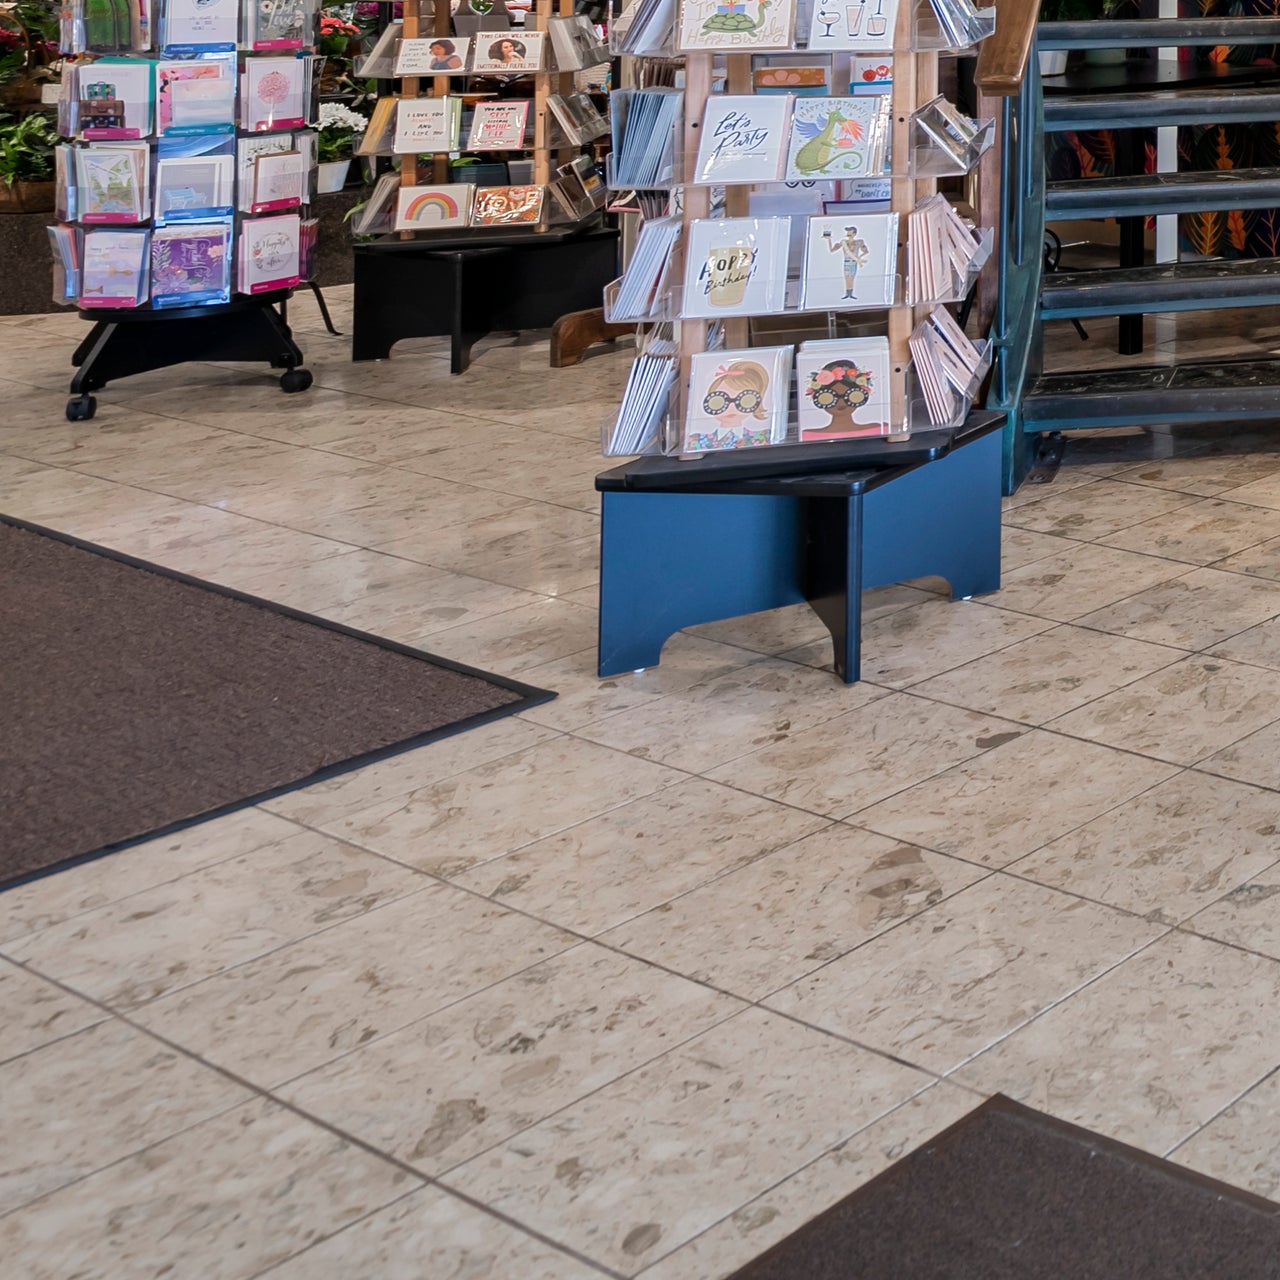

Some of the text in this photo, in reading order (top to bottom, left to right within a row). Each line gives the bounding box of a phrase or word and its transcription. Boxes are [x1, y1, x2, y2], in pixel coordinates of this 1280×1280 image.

[800, 99, 868, 118] HAPPY BIRTHDAY!
[713, 111, 751, 137] Let's
[715, 127, 769, 159] Party
[704, 265, 757, 295] Birthday!
